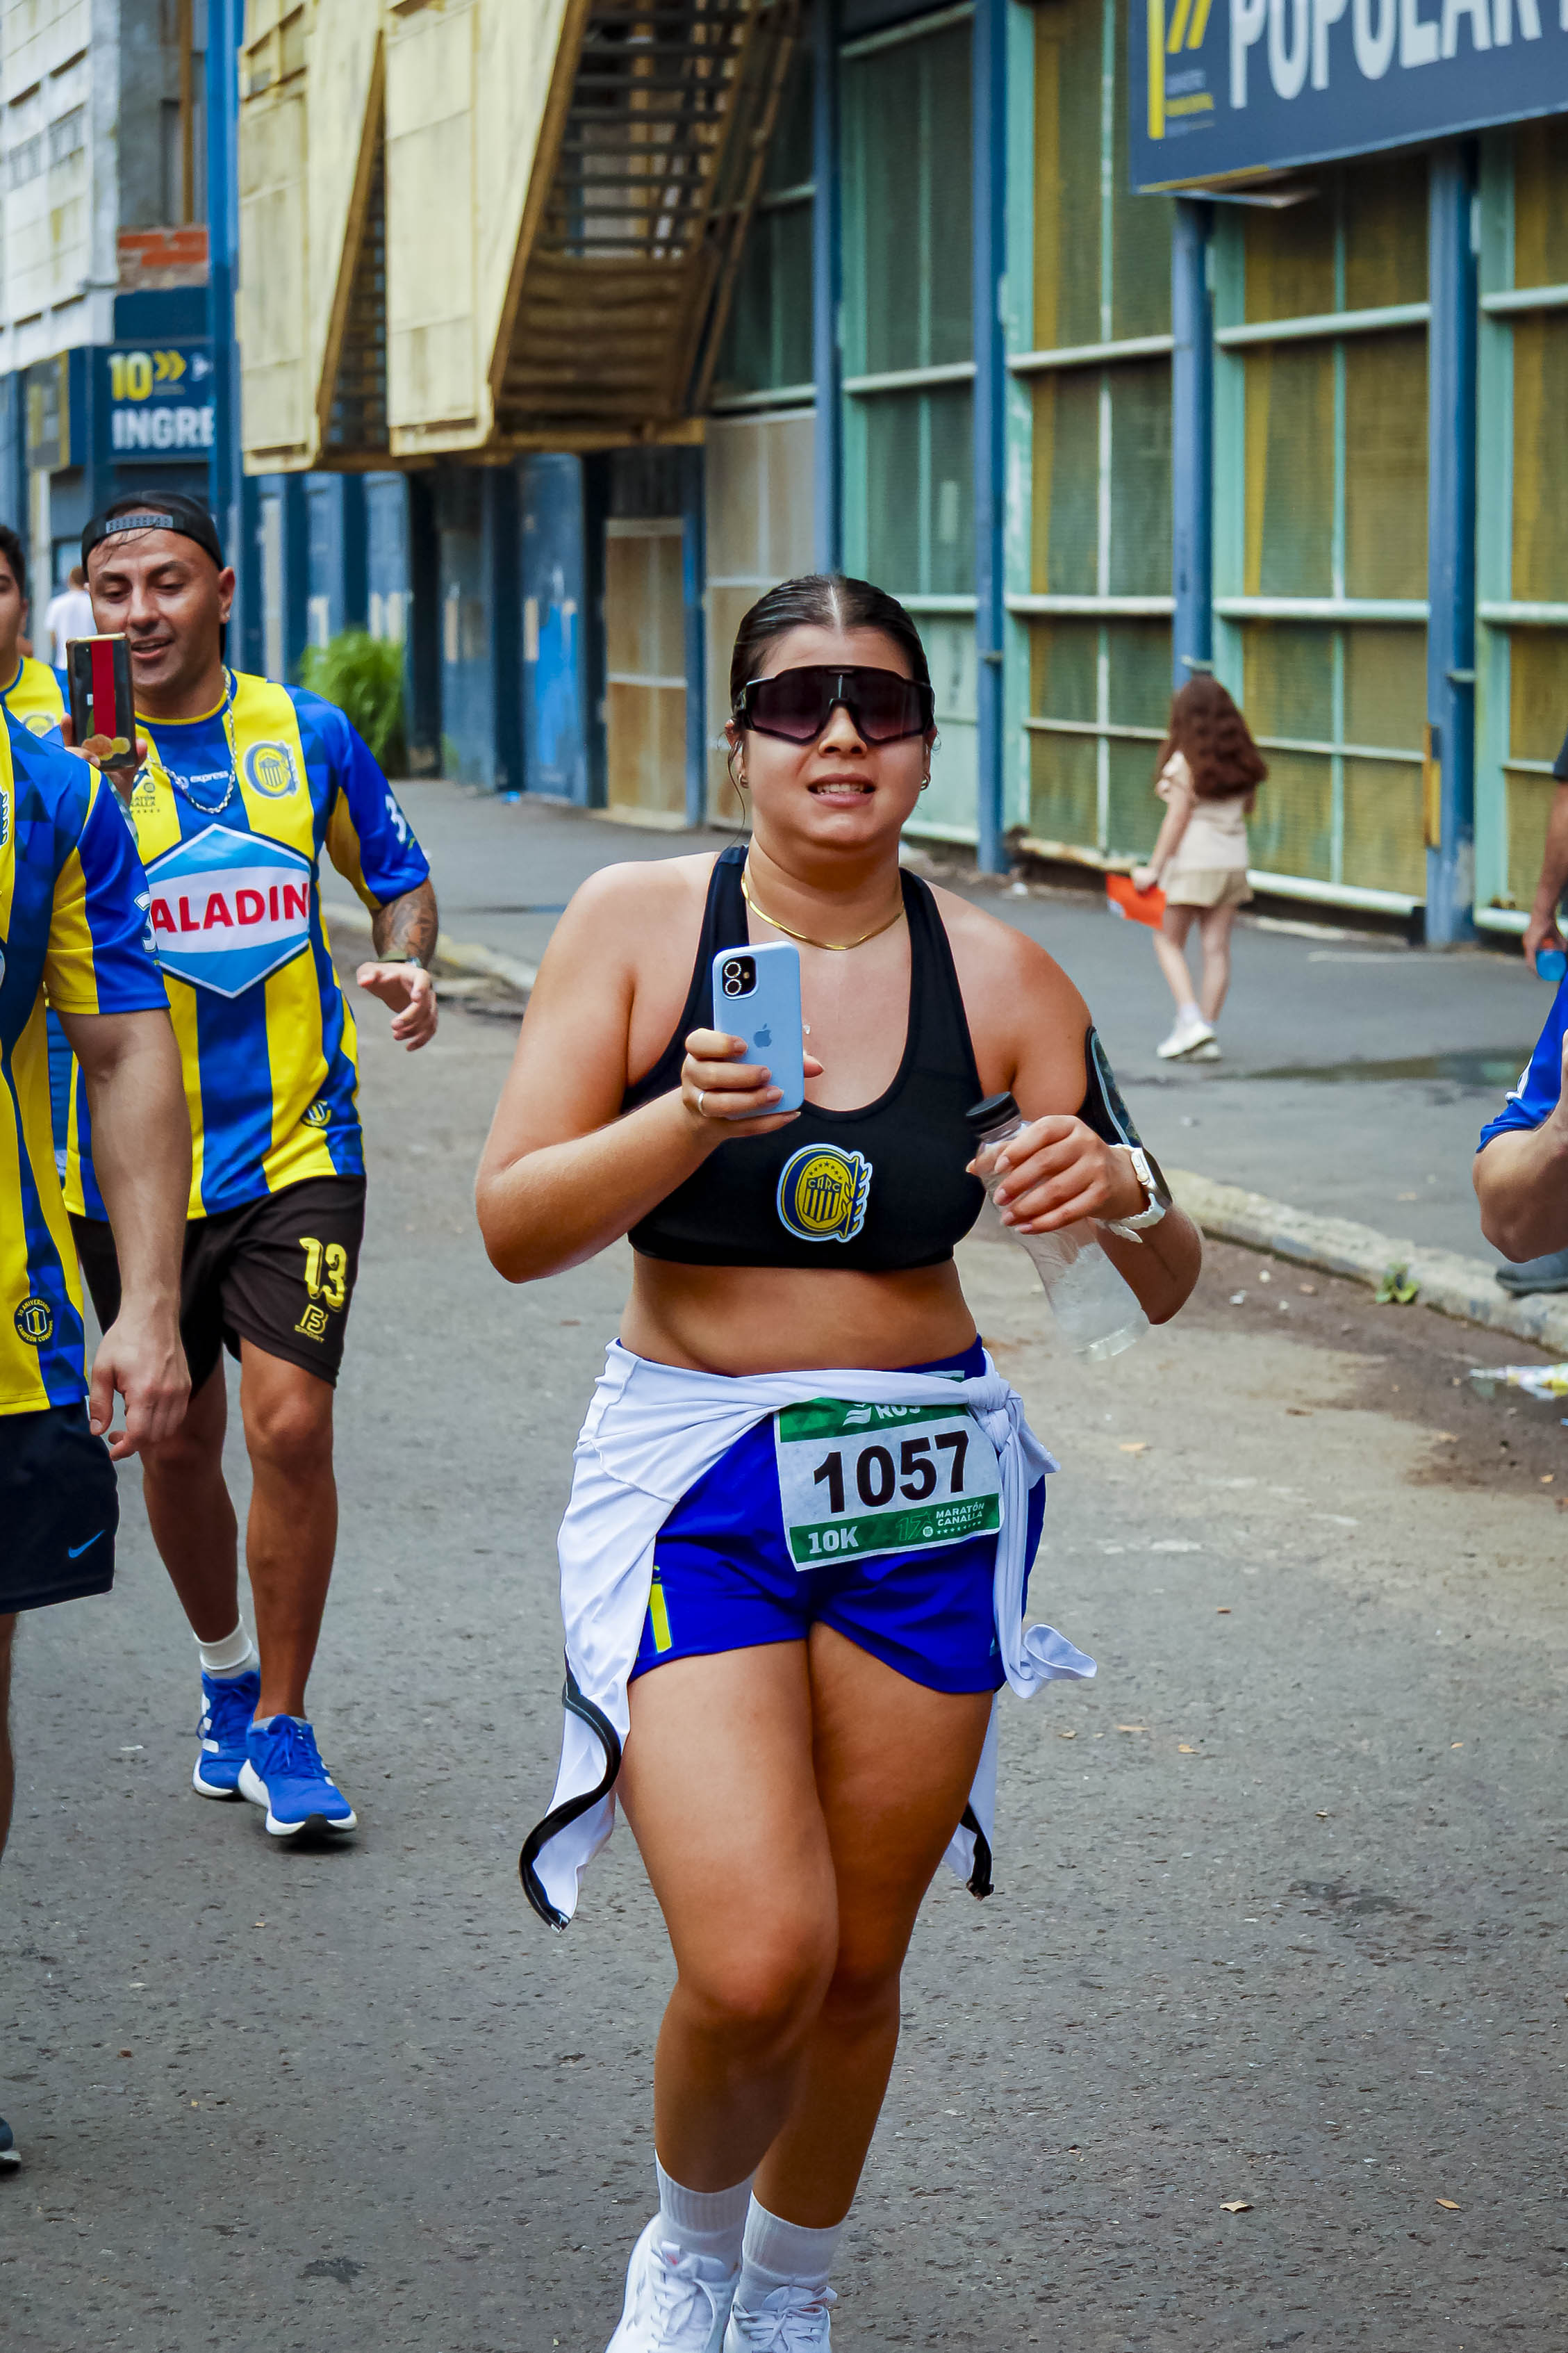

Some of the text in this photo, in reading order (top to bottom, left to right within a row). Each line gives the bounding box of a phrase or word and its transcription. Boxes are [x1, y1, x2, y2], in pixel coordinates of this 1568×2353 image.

[808, 1174, 841, 1192] CARC
[299, 1237, 347, 1312] 13
[814, 1429, 969, 1514] 1057
[936, 1501, 985, 1519] MARATÓN
[937, 1511, 982, 1526] CANALLA
[808, 1525, 859, 1554] 10K
